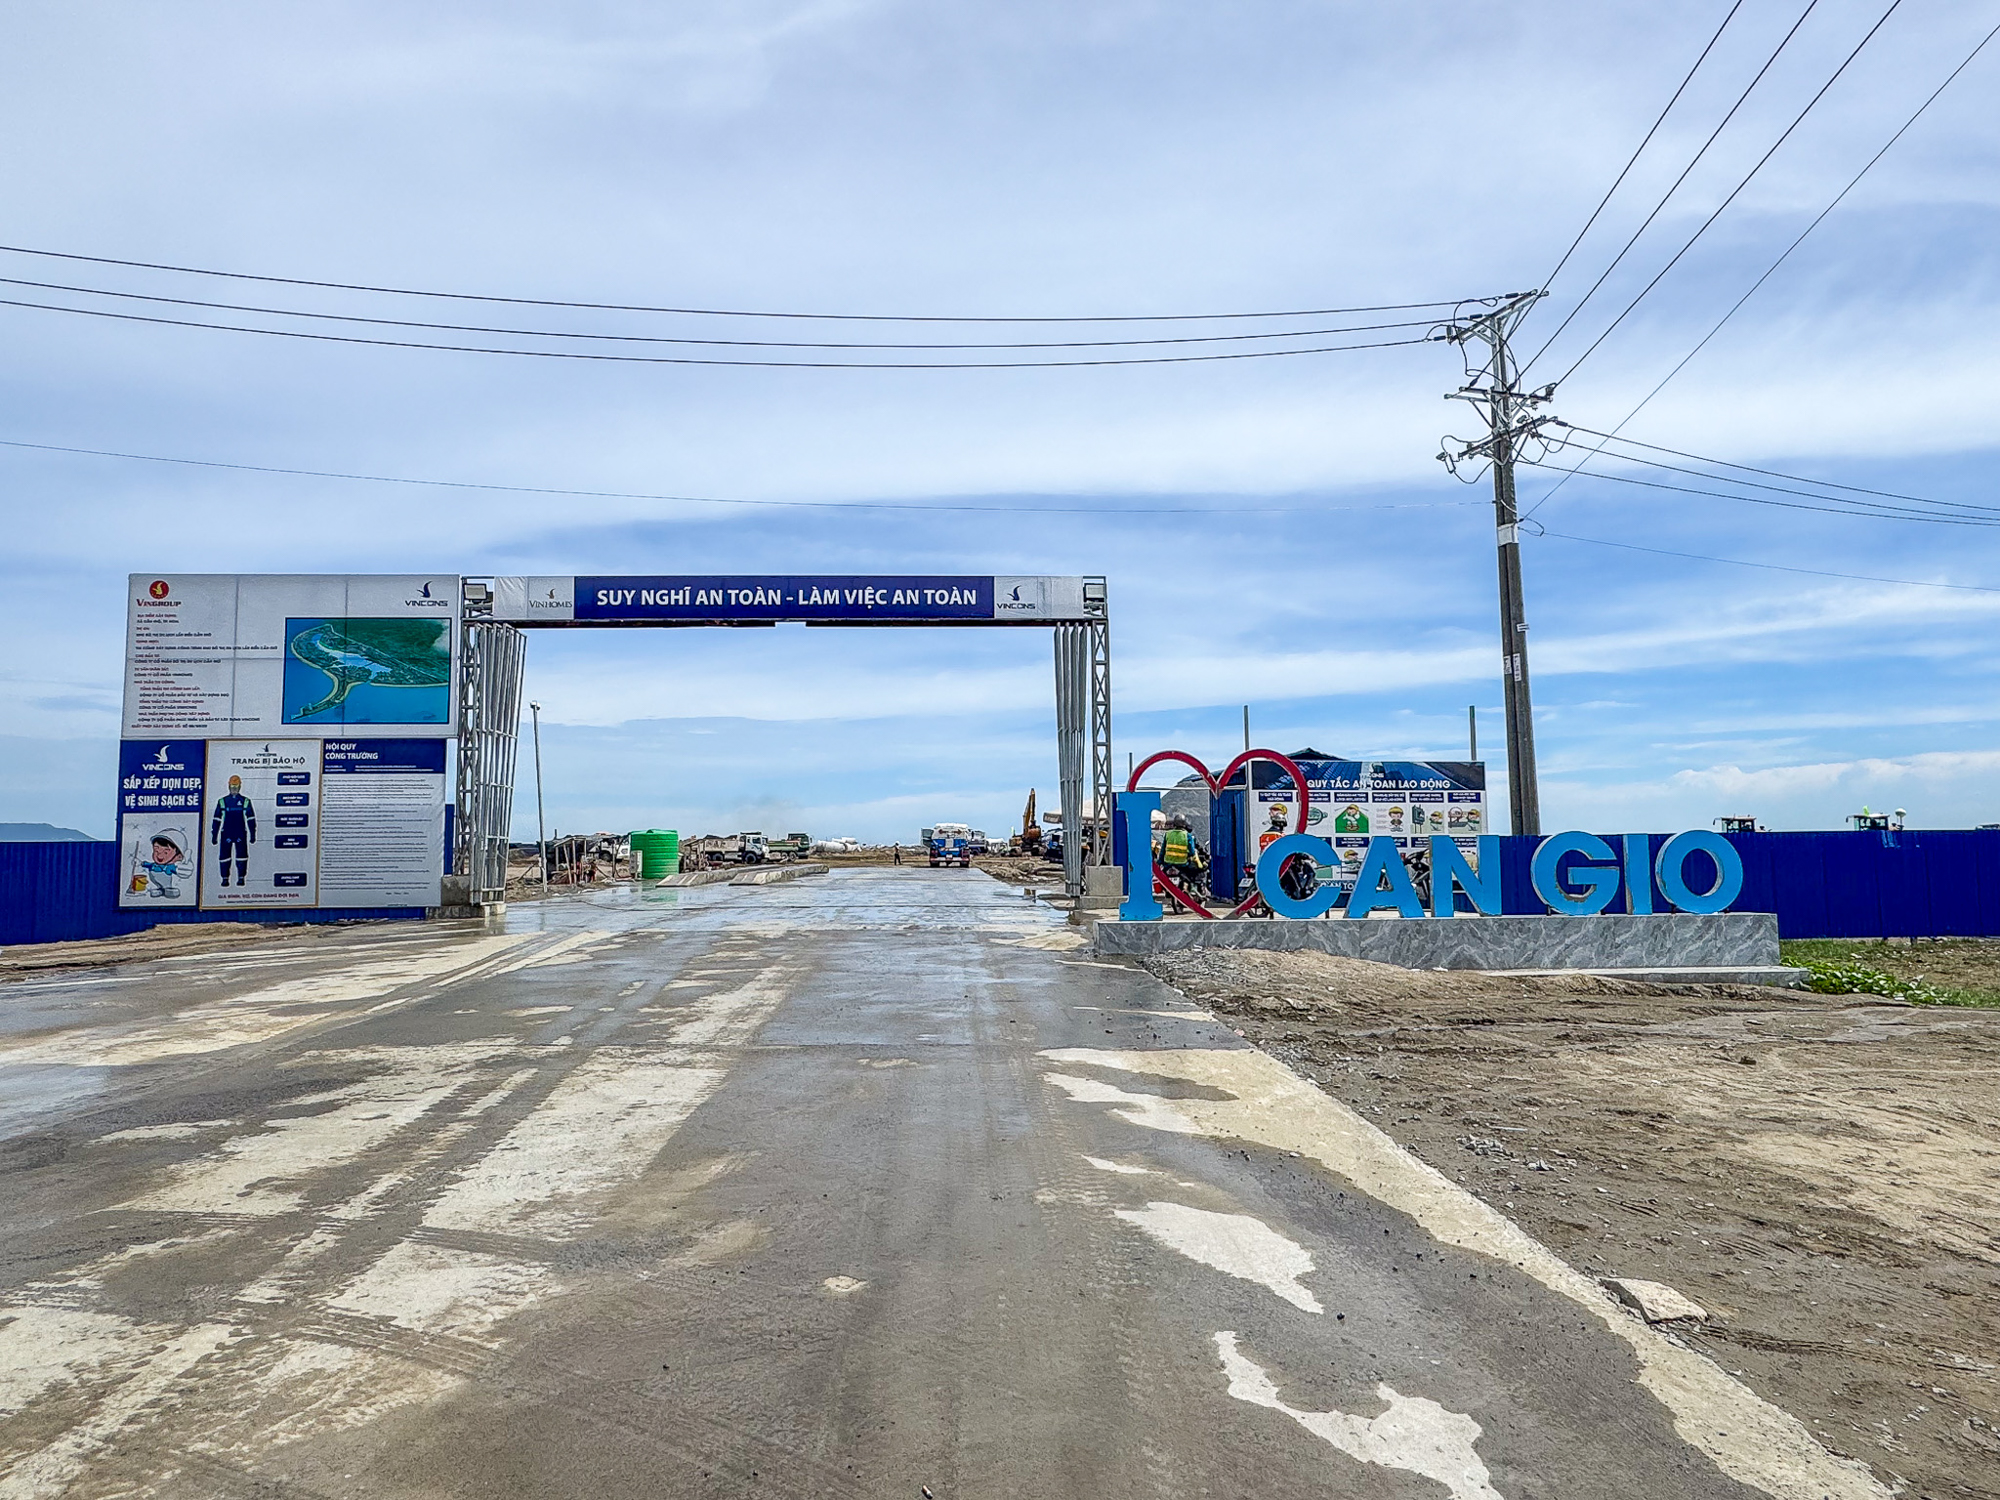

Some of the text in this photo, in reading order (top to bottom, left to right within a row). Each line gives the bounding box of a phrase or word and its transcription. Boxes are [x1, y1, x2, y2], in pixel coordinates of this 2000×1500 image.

[597, 589, 636, 606] SUY
[641, 586, 692, 606] NGHĨ
[696, 589, 726, 606] AN
[727, 586, 782, 606] TOÀN
[798, 586, 840, 606] LÀM
[844, 585, 888, 610] VIỆC
[892, 589, 922, 605] AN
[923, 585, 977, 605] TOÀN
[529, 600, 573, 609] VINHOMES
[996, 602, 1036, 610] VINCONS
[325, 742, 357, 752] NỘI QUY
[325, 751, 347, 760] CÔNG
[231, 757, 261, 765] TRANG
[142, 763, 185, 771] VINCONS
[123, 773, 202, 791] SẮP XẾP DỌN DẸP,
[1307, 779, 1328, 789] QUY
[1353, 779, 1367, 789] AN
[1398, 779, 1418, 789] LAO
[1420, 777, 1451, 791] ĐỘNG
[125, 793, 136, 809] VỆ
[137, 795, 159, 807] SINH
[161, 794, 185, 809] SẠCH
[1117, 792, 1744, 921] I CAN GIO
